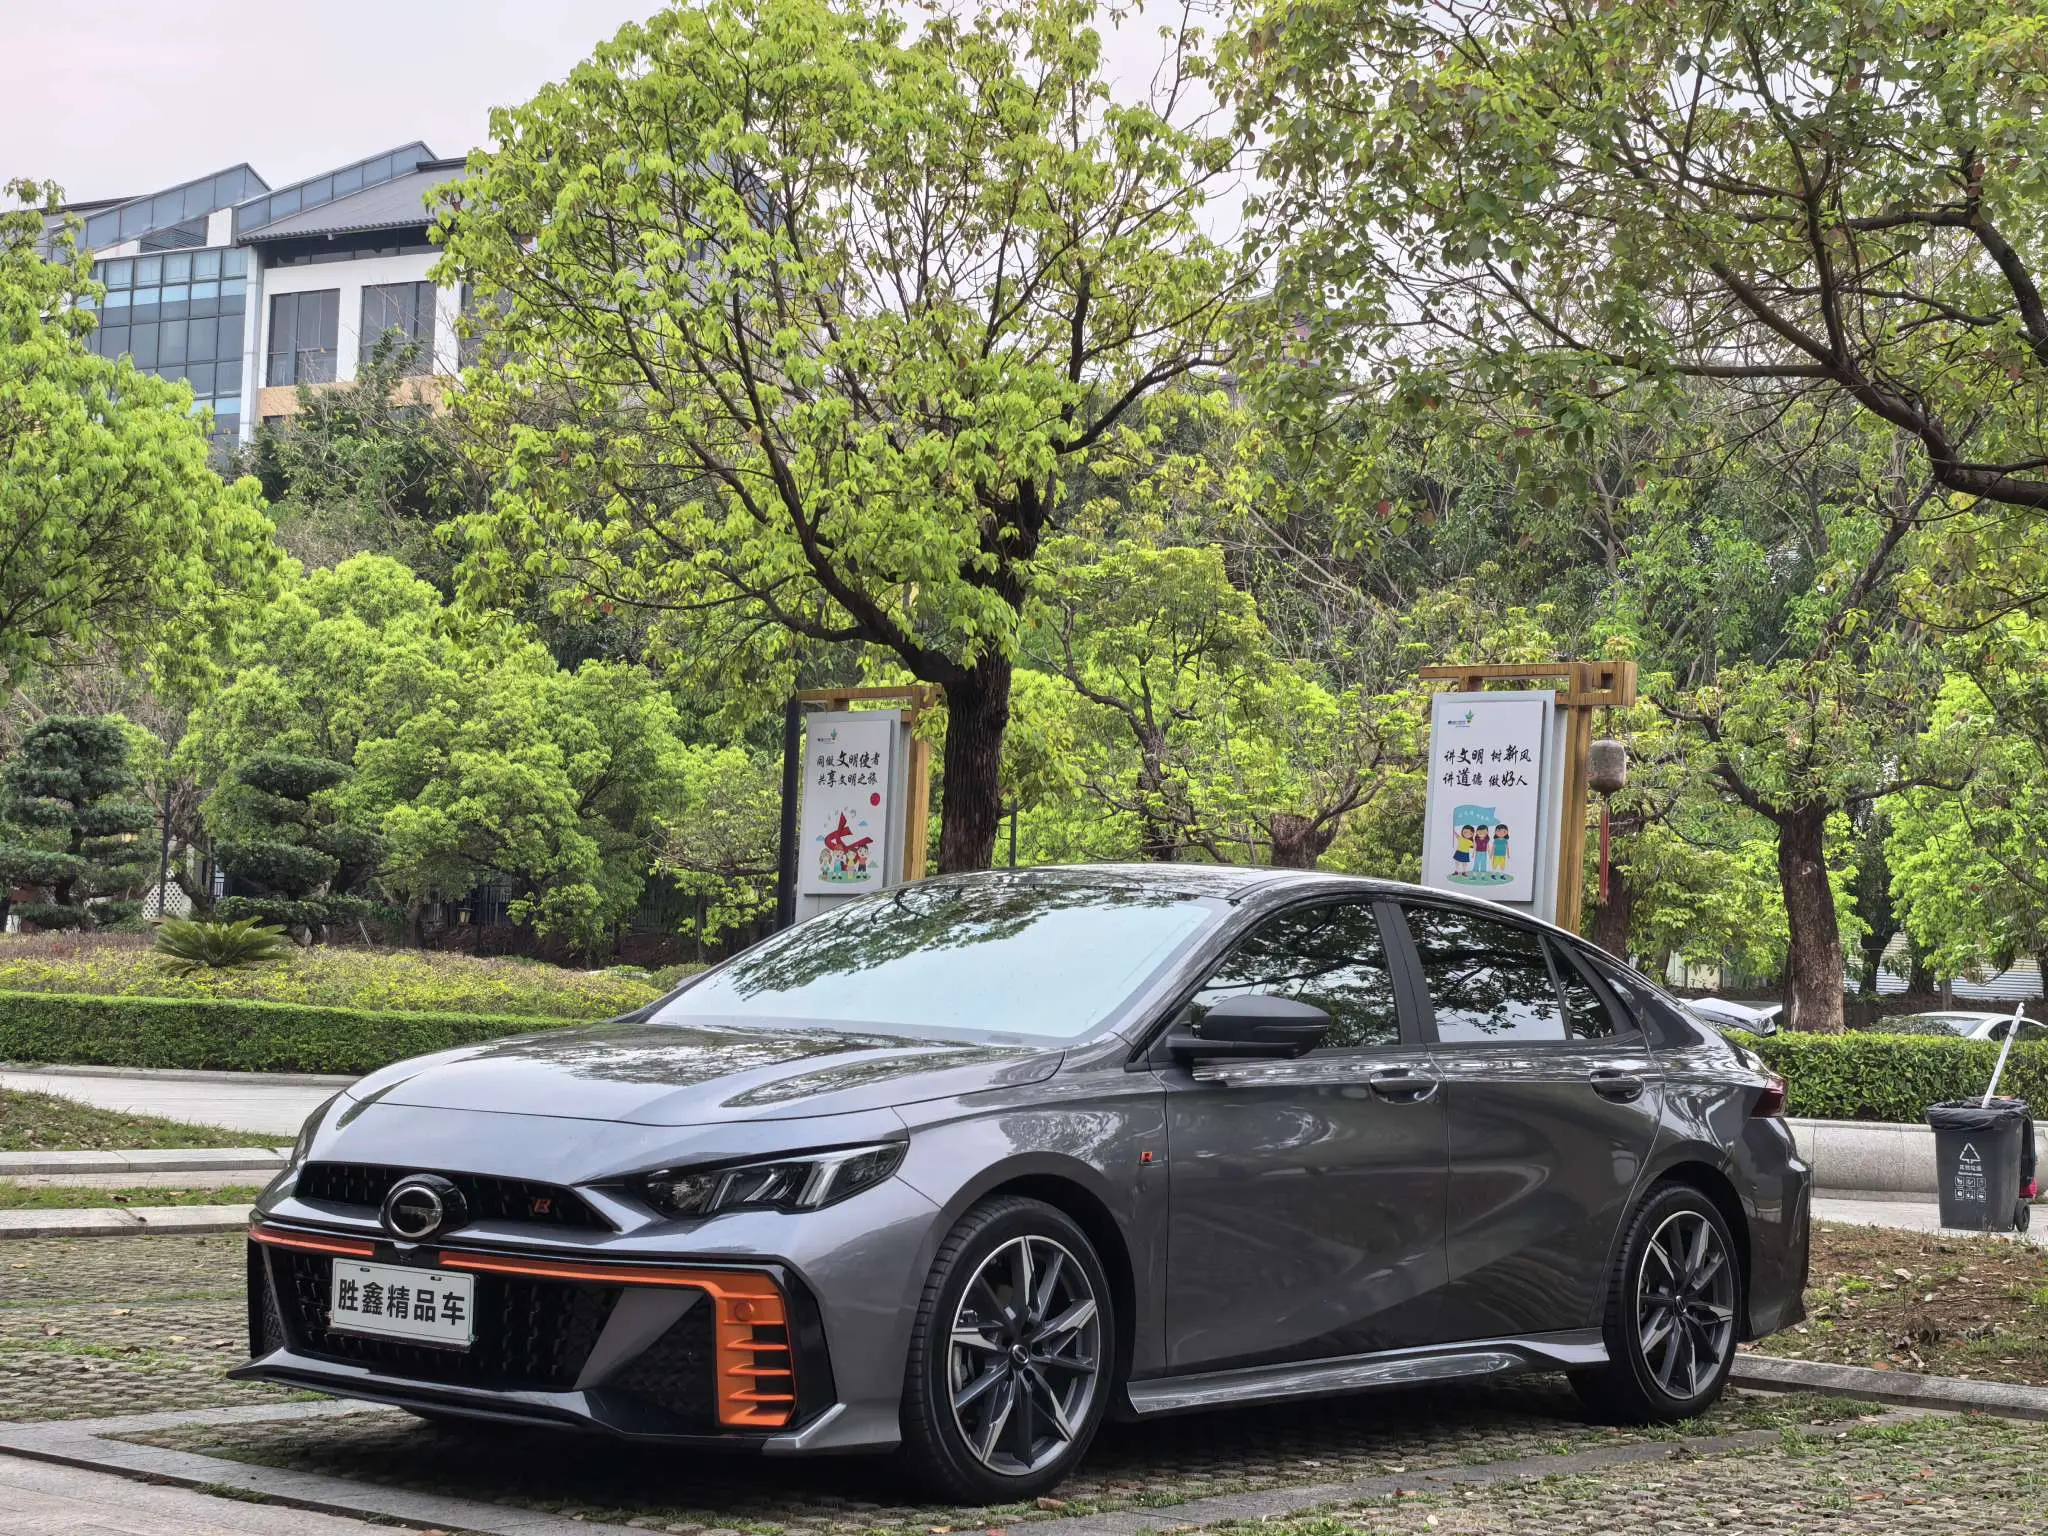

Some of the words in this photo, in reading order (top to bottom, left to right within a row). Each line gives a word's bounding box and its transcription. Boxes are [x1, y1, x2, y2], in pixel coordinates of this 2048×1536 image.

[816, 750, 880, 768] 同做文明使者
[1444, 747, 1484, 765] 讲文明
[1490, 744, 1532, 764] 树新风
[817, 770, 878, 788] 共享文明之旅
[1442, 767, 1483, 787] 讲道德
[1488, 770, 1528, 788] 做好人
[338, 1279, 465, 1326] 胜鑫精品车
